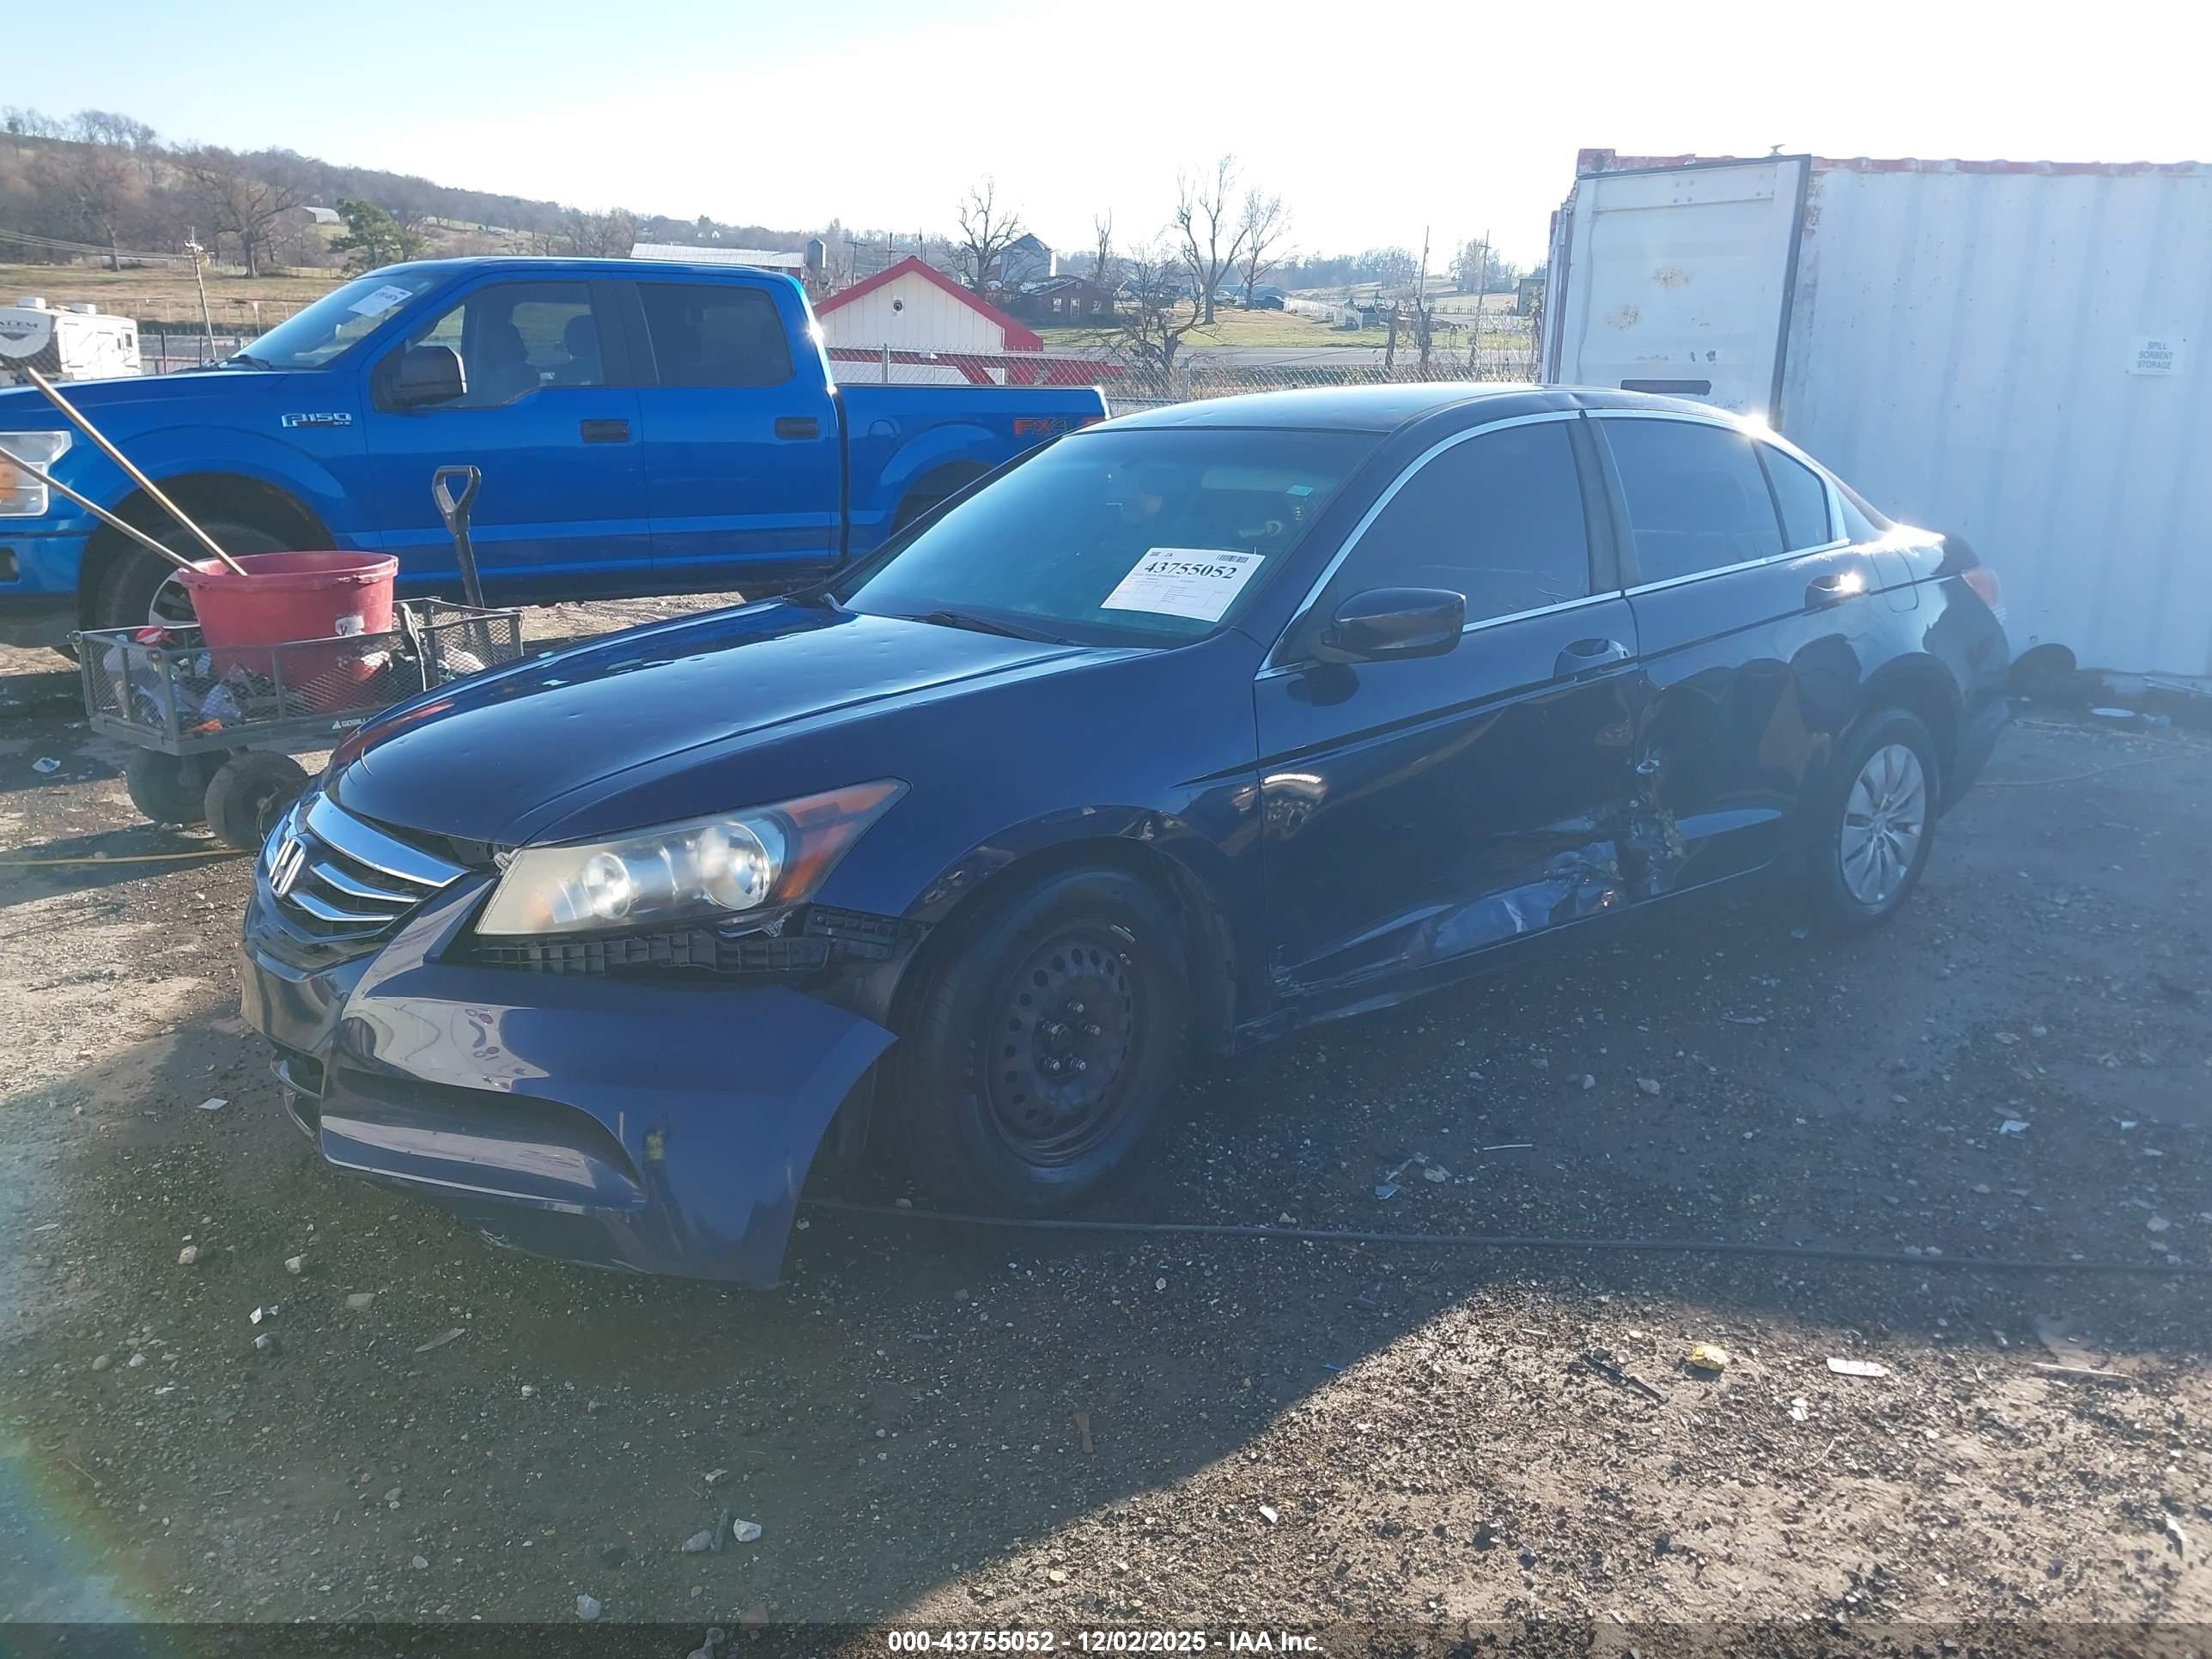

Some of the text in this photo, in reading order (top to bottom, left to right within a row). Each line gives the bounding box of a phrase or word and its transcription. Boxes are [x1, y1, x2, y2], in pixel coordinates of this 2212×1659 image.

[2148, 342, 2168, 350] SPILL
[2136, 361, 2172, 369] STORAGE
[1145, 562, 1237, 579] 43755052
